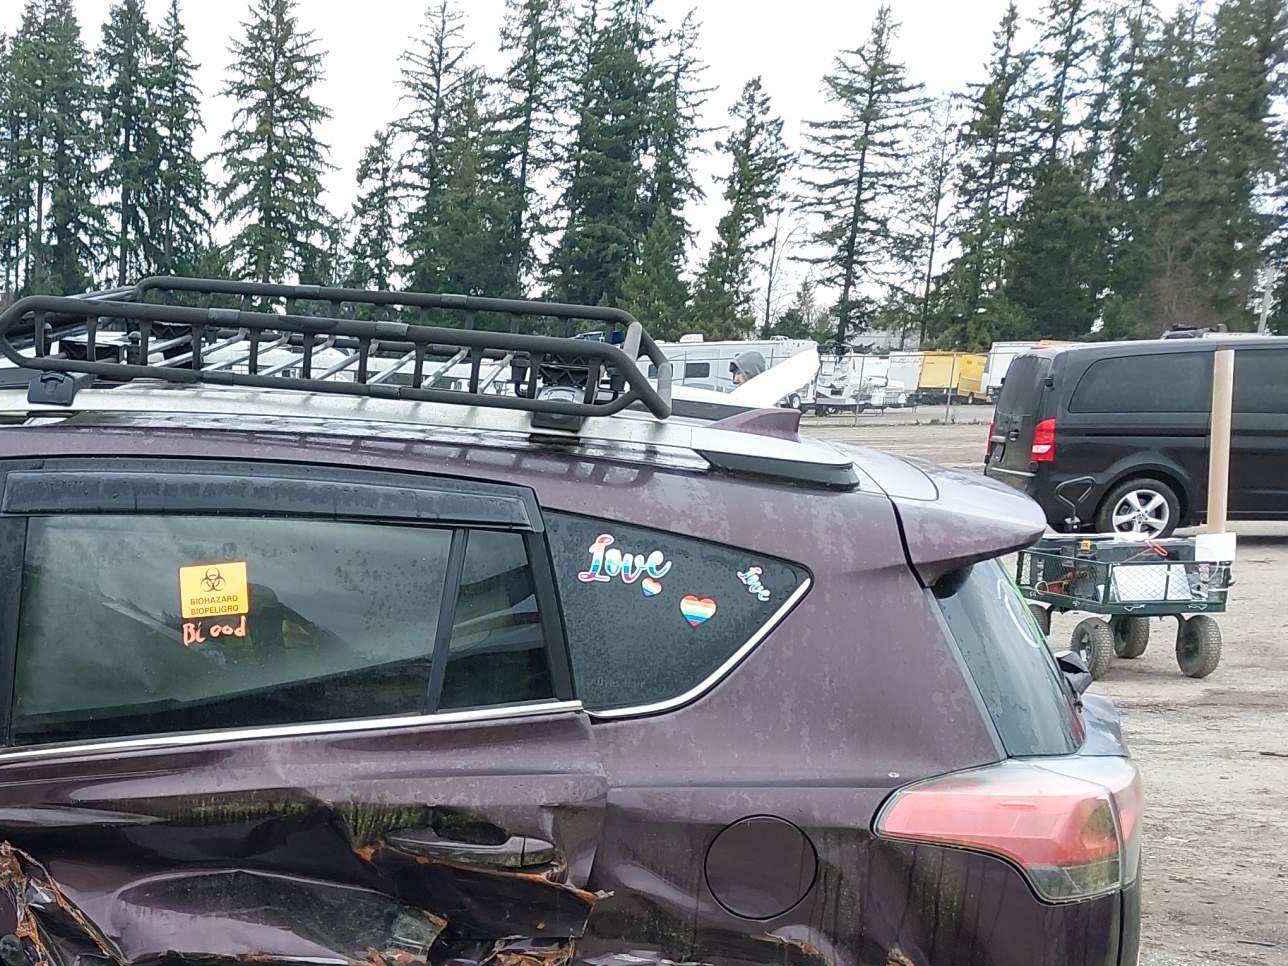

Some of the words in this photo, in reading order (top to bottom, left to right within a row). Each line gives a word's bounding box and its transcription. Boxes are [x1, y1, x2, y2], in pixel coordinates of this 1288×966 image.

[578, 533, 673, 584] Love
[736, 566, 772, 602] Love
[190, 594, 239, 606] BIOHAZARD
[190, 604, 240, 616] BIOPELIGRO
